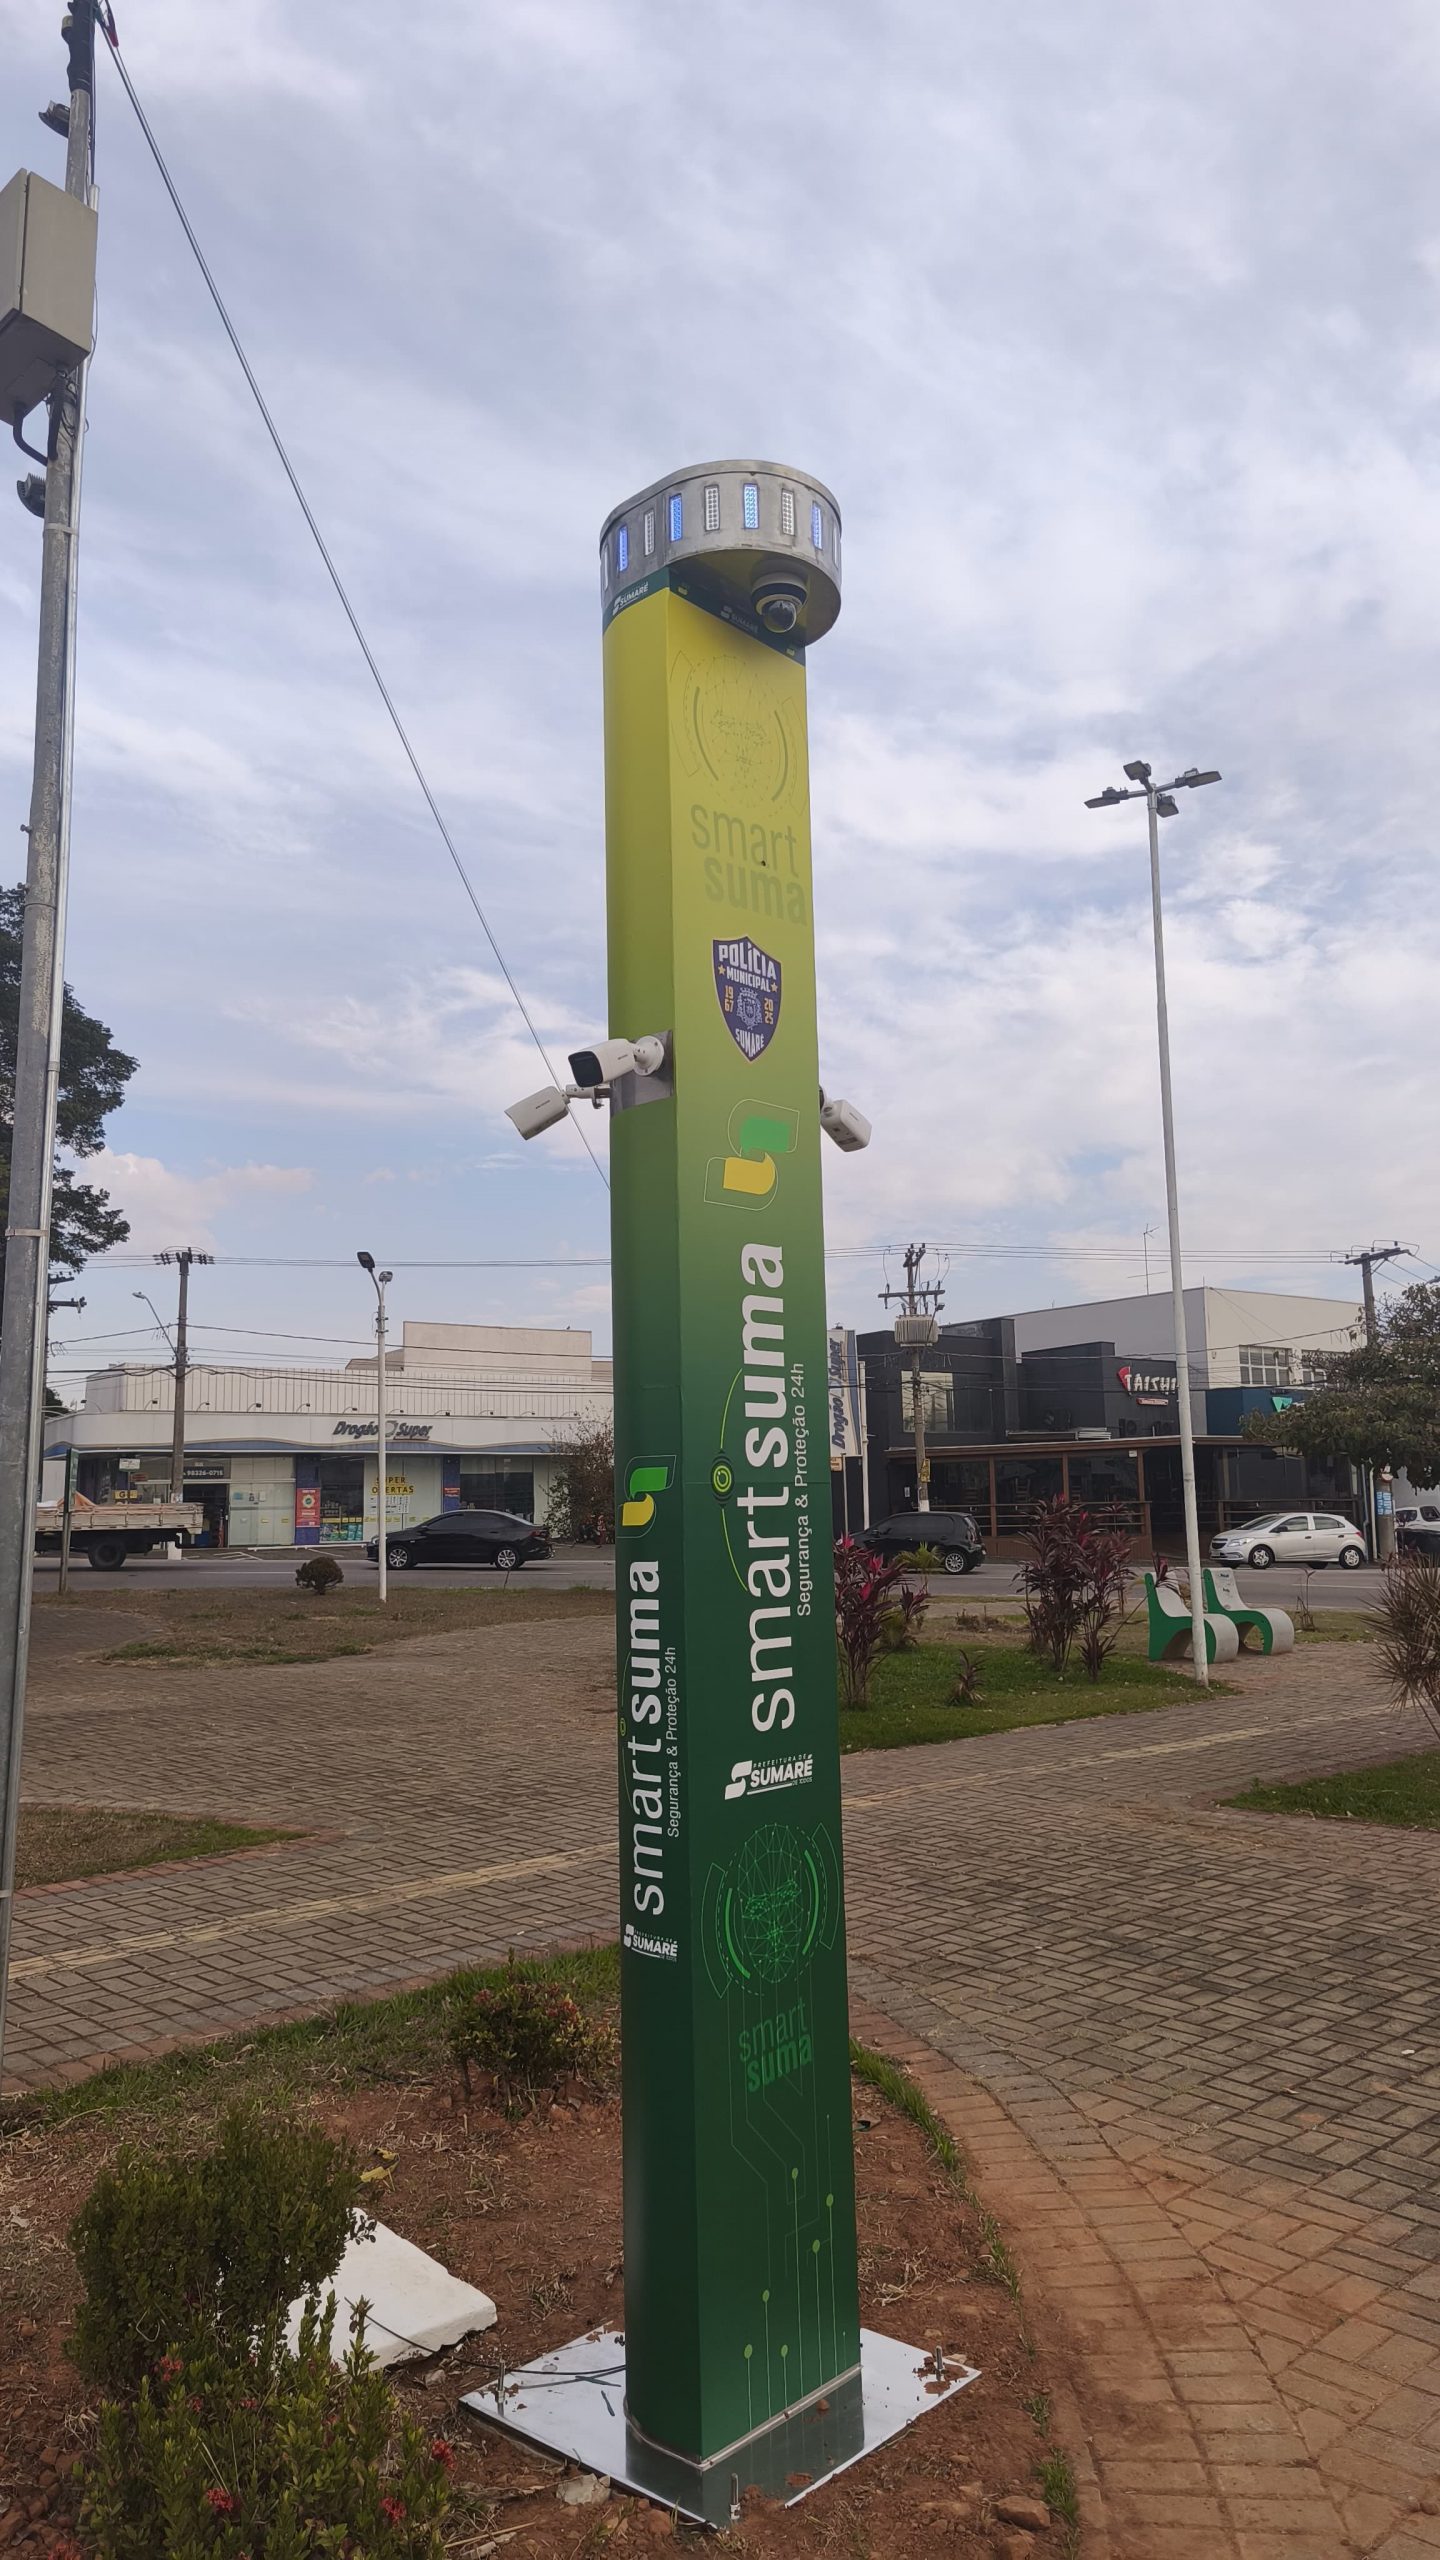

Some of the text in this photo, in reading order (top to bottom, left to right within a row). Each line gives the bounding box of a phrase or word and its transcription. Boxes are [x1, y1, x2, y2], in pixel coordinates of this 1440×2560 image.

[691, 804, 799, 878] smart
[704, 857, 807, 926] suma
[718, 942, 776, 980] POLÍCIA
[725, 985, 734, 999] 19
[726, 966, 771, 992] MUNICIPAL
[725, 999, 734, 1012] 67
[764, 998, 773, 1012] 20
[764, 1011, 773, 1024] 25
[735, 1028, 764, 1057] SUMARÉ
[396, 1423, 432, 1438] Super
[372, 1486, 414, 1494] OERTAS
[737, 1243, 795, 1732] smart suma
[791, 1363, 812, 1616] Segurança & Proteção 24h
[629, 1560, 662, 1725] suma
[664, 1647, 681, 1838] Segurança & Proteção 24h
[750, 1754, 813, 1788] SUMARÉ
[753, 1755, 797, 1768] PREFEITURA
[628, 1736, 664, 1915] smart
[633, 1935, 678, 1957] SUMARÉ
[739, 1997, 808, 2062] smart
[747, 2034, 812, 2092] suma
